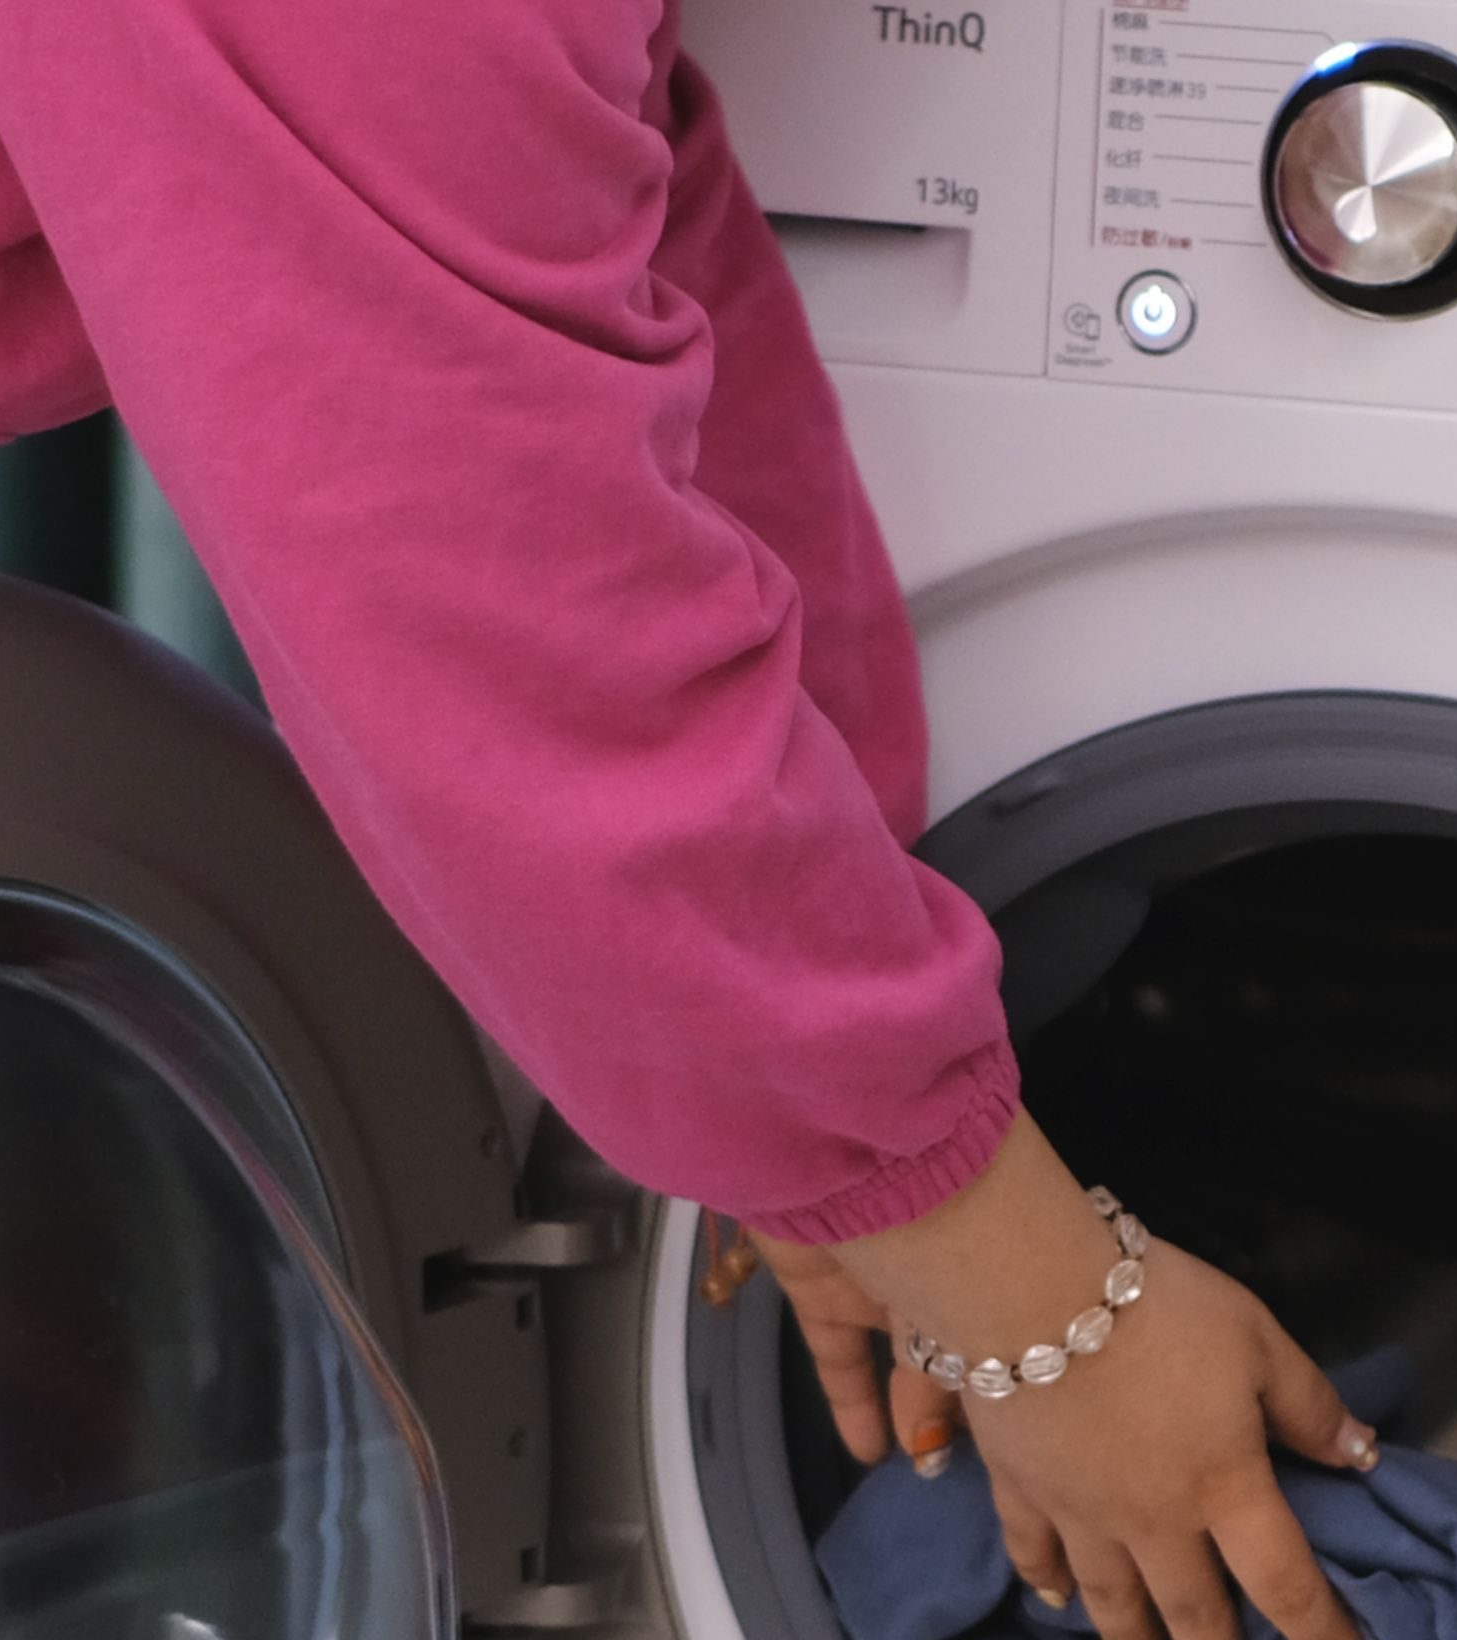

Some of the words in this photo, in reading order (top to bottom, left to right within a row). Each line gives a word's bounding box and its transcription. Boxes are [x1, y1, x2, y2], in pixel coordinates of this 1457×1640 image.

[872, 5, 985, 53] ThinQ
[1105, 149, 1143, 169] 化纤
[916, 176, 980, 216] 13kg
